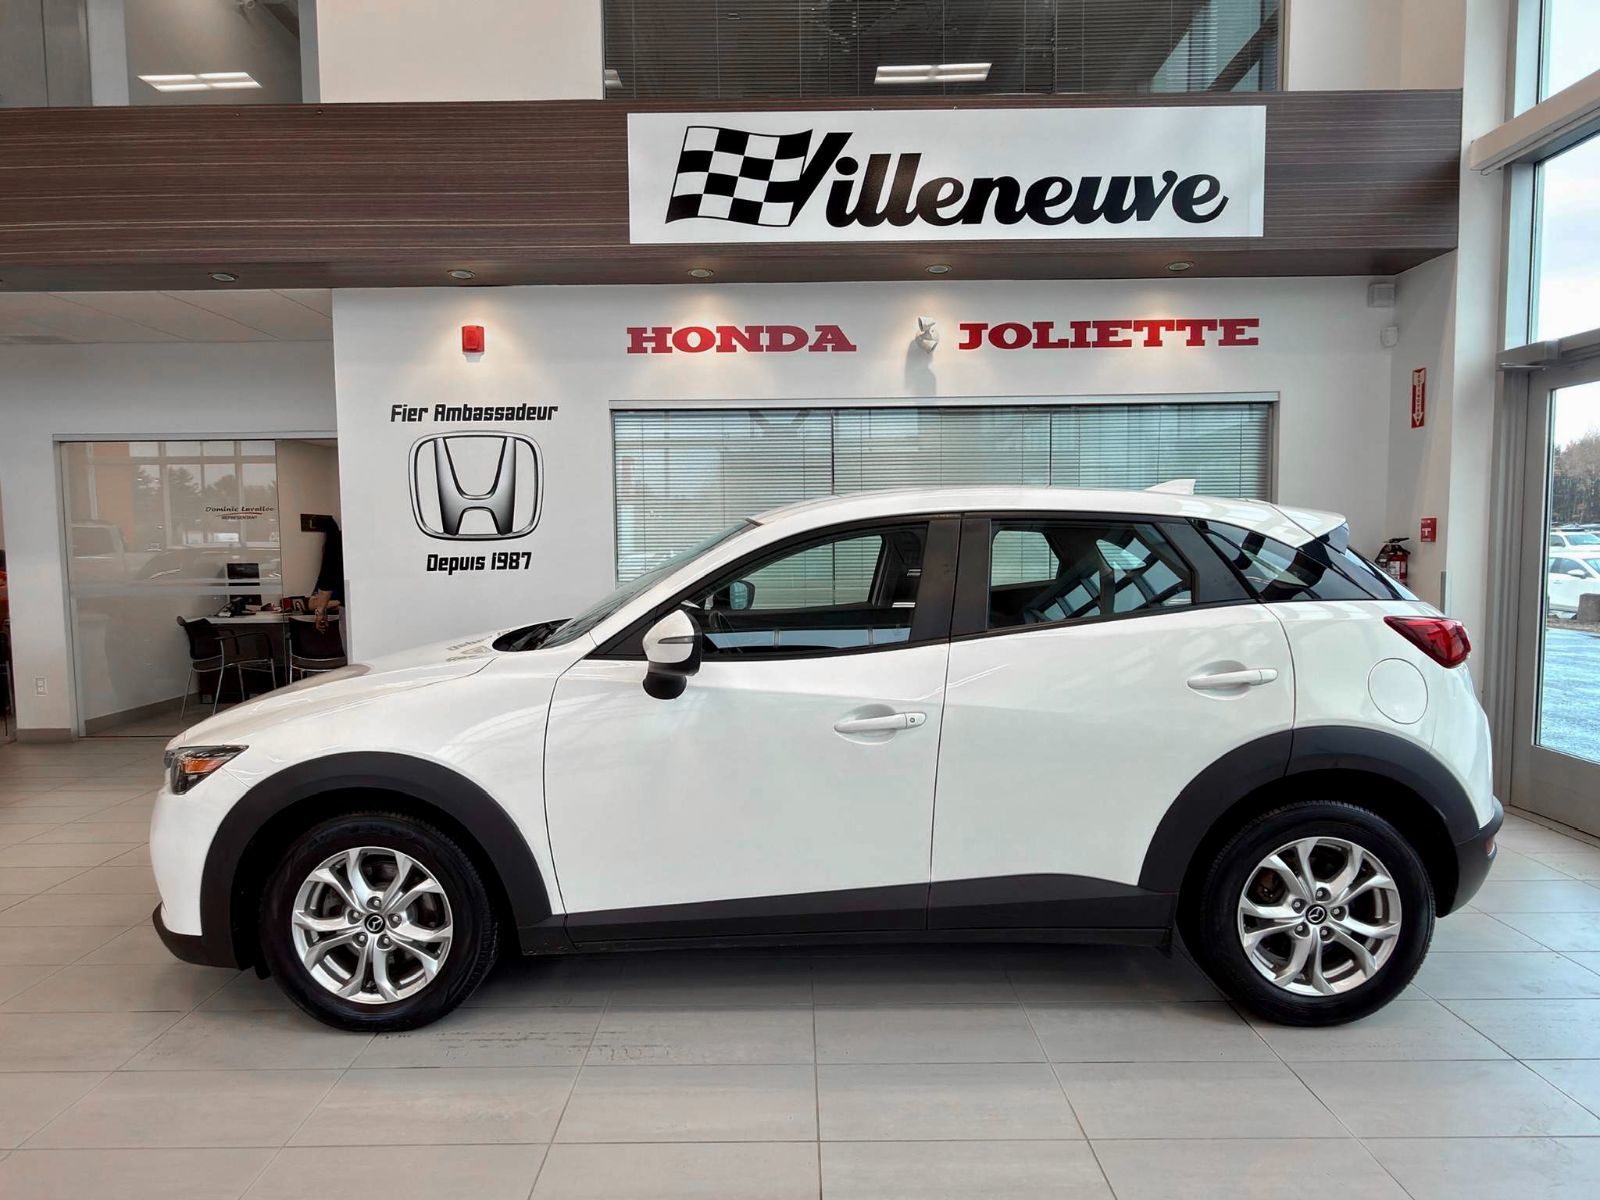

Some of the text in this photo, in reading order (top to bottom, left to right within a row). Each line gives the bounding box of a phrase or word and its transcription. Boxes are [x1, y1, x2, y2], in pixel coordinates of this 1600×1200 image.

[788, 131, 1229, 228] Villeneuve
[627, 326, 857, 353] HONDA
[958, 318, 1260, 351] JOLIETTE
[390, 403, 559, 423] Fier Ambassadeur
[426, 551, 532, 576] Depuis 1987
